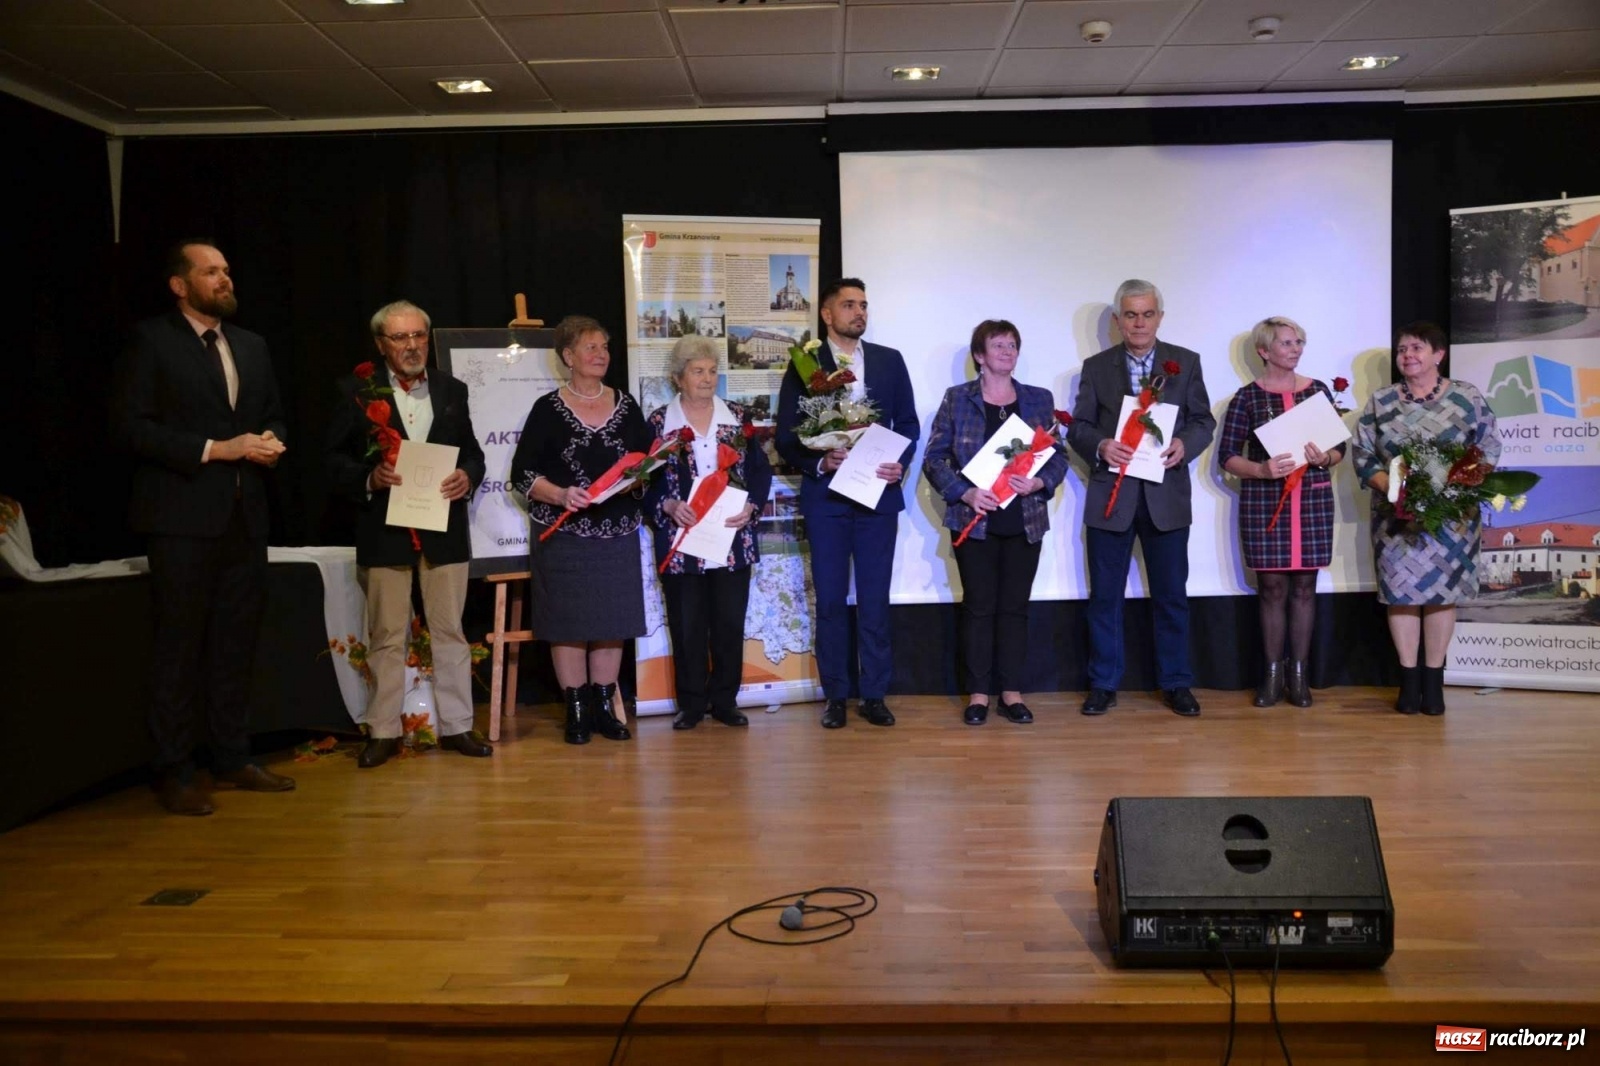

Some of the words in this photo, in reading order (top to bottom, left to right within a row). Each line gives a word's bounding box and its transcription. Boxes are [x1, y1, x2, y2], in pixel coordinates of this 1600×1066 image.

[682, 233, 721, 241] Krzanowice
[1553, 422, 1600, 438] racib
[1544, 443, 1585, 453] oaza
[497, 537, 528, 546] GMINA
[1136, 917, 1154, 934] HK
